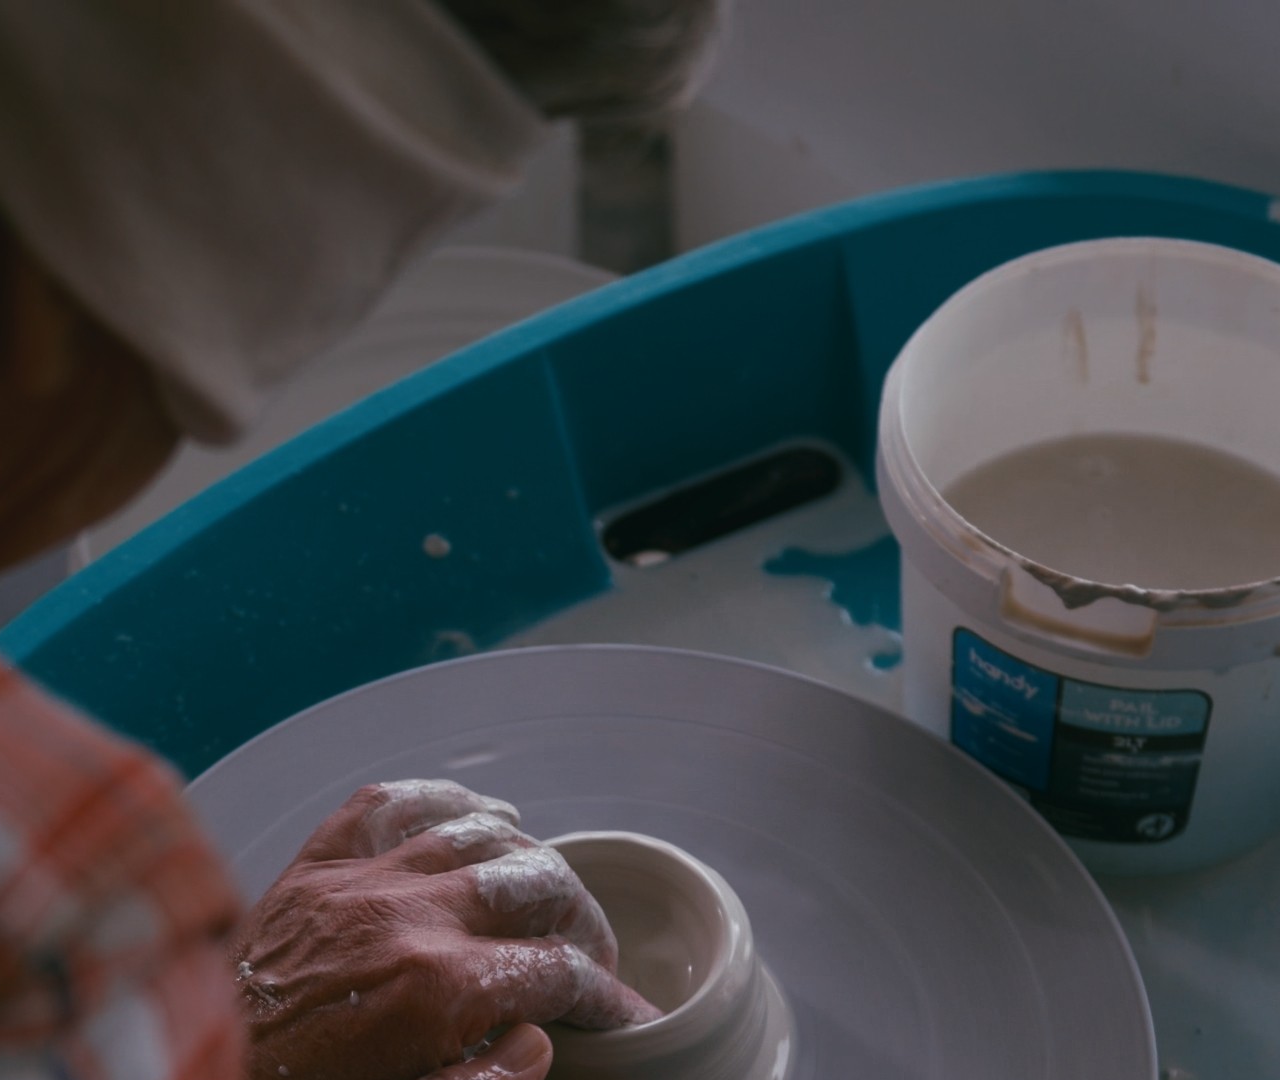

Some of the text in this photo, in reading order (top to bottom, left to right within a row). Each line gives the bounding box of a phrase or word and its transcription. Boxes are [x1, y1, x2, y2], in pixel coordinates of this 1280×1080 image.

[968, 647, 1039, 699] handy
[1084, 709, 1183, 728] WITH LID
